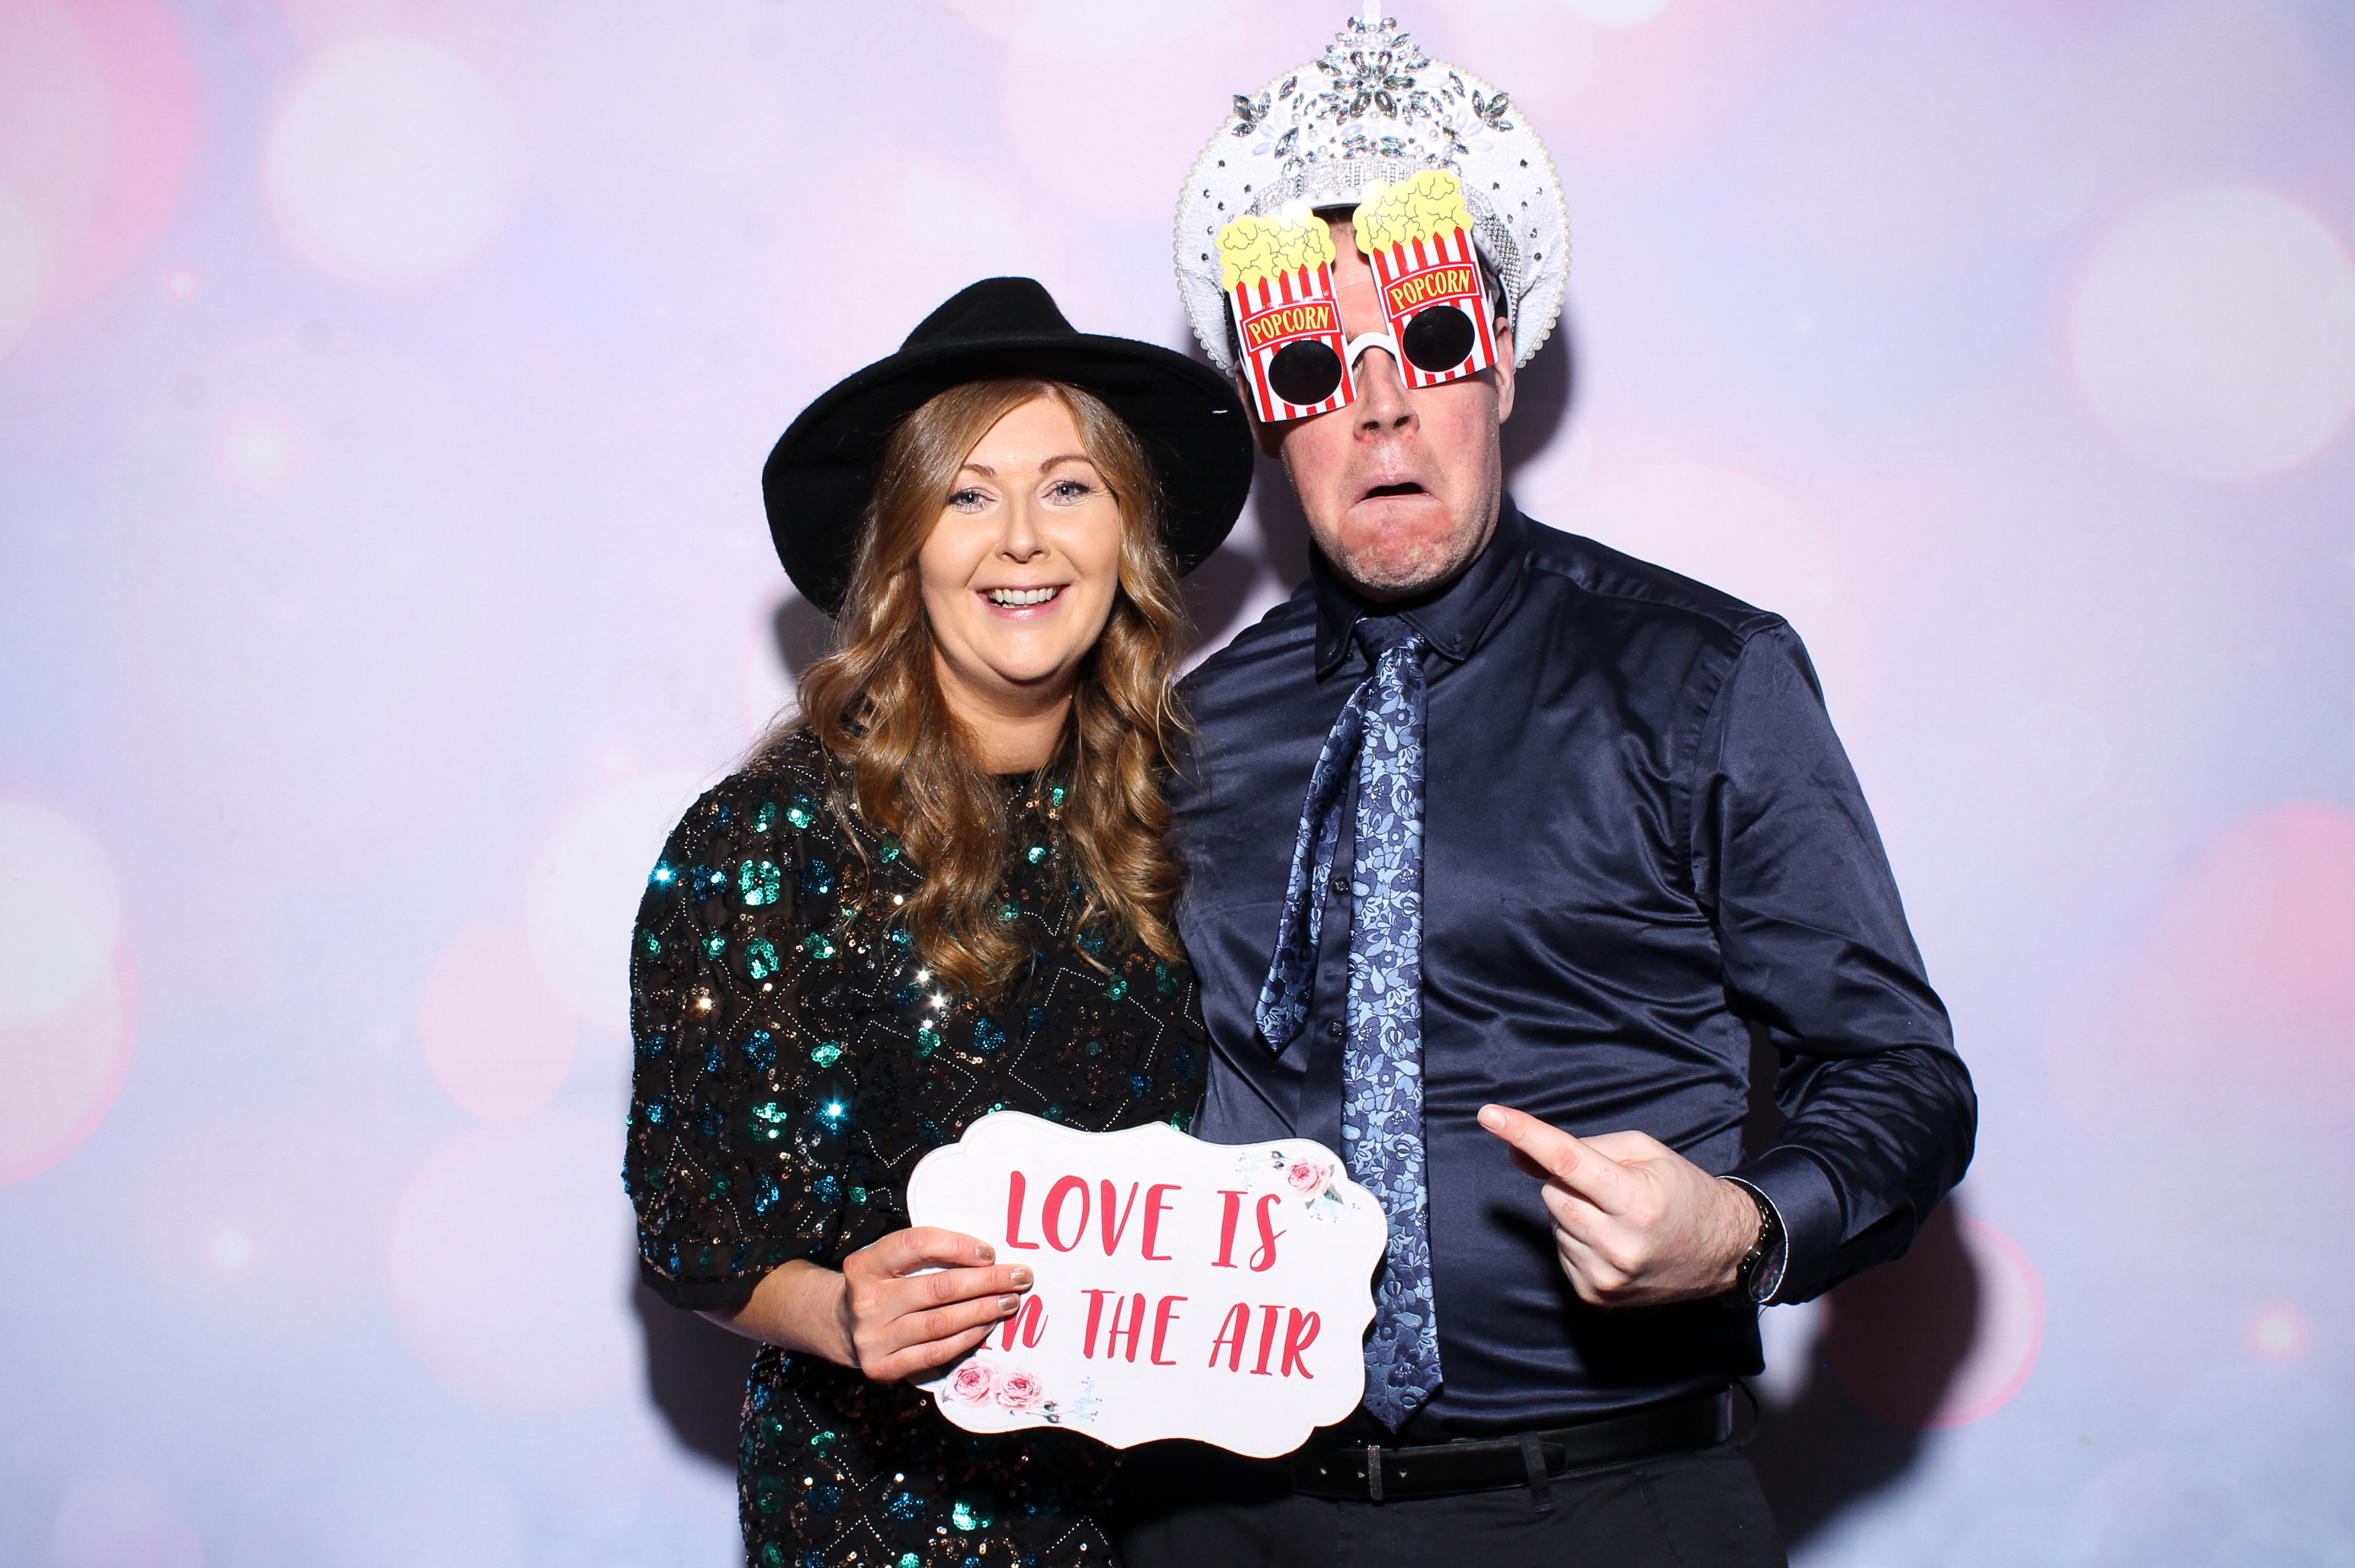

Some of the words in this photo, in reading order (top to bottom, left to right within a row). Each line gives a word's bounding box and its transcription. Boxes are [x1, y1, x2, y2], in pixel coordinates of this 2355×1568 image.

[1390, 269, 1471, 310] POPCORN
[1247, 306, 1330, 345] POPCORN
[1006, 1170, 1183, 1261] LOVE
[1211, 1190, 1287, 1273] IS
[1081, 1288, 1189, 1366] THE
[1209, 1302, 1322, 1380] AIR
